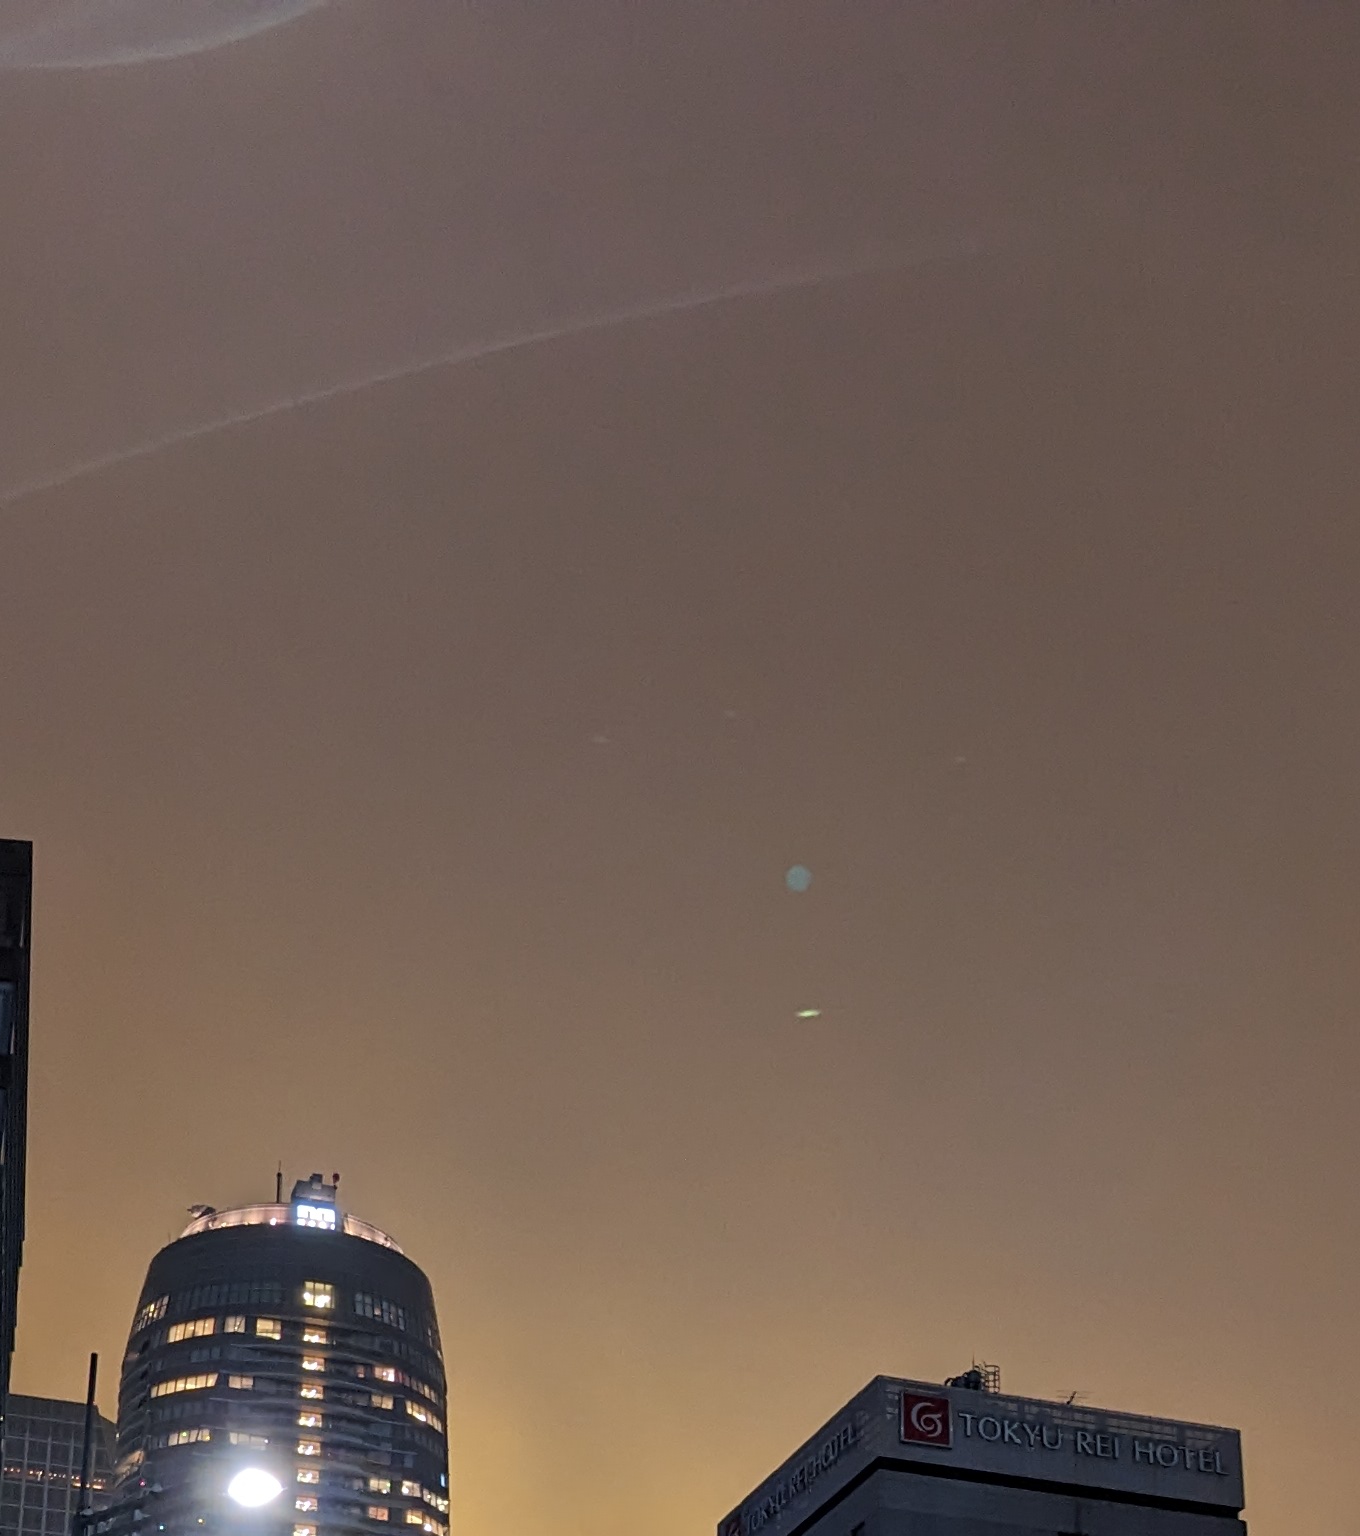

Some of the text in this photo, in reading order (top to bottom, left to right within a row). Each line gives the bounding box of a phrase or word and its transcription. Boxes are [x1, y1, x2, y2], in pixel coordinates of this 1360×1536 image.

[958, 1411, 1230, 1476] TOKYU REI HOTEL
